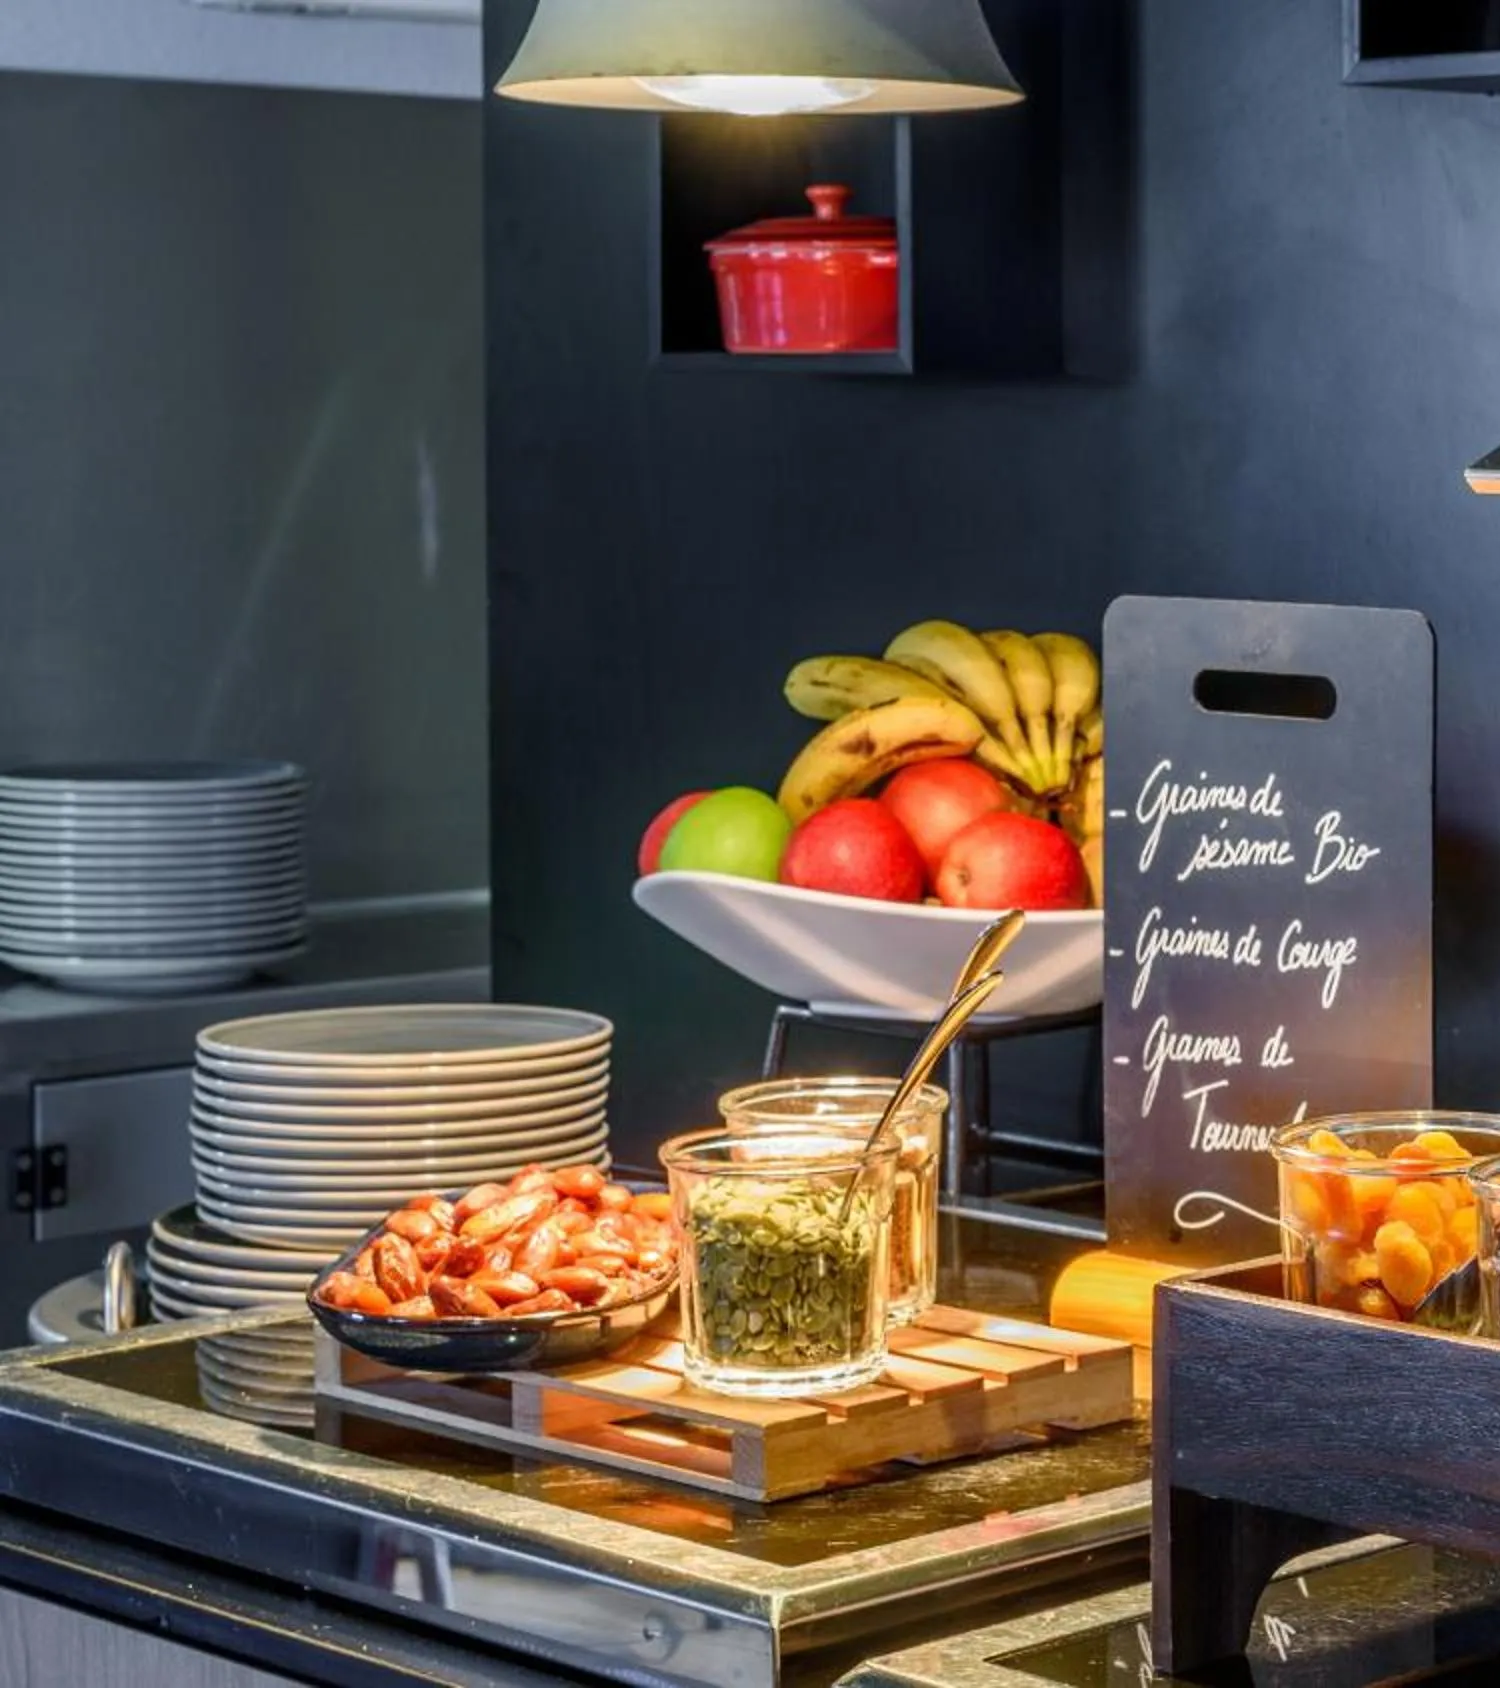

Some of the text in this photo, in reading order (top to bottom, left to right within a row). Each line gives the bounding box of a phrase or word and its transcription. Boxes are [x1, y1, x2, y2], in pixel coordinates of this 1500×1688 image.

[1136, 760, 1247, 873] Graines
[1250, 773, 1283, 817] de
[1305, 811, 1381, 884] Bio
[1134, 906, 1229, 1009] Graines
[1234, 925, 1260, 966] de
[1278, 920, 1357, 1008] Courge
[1143, 1015, 1241, 1118] Graines
[1261, 1026, 1293, 1068] de
